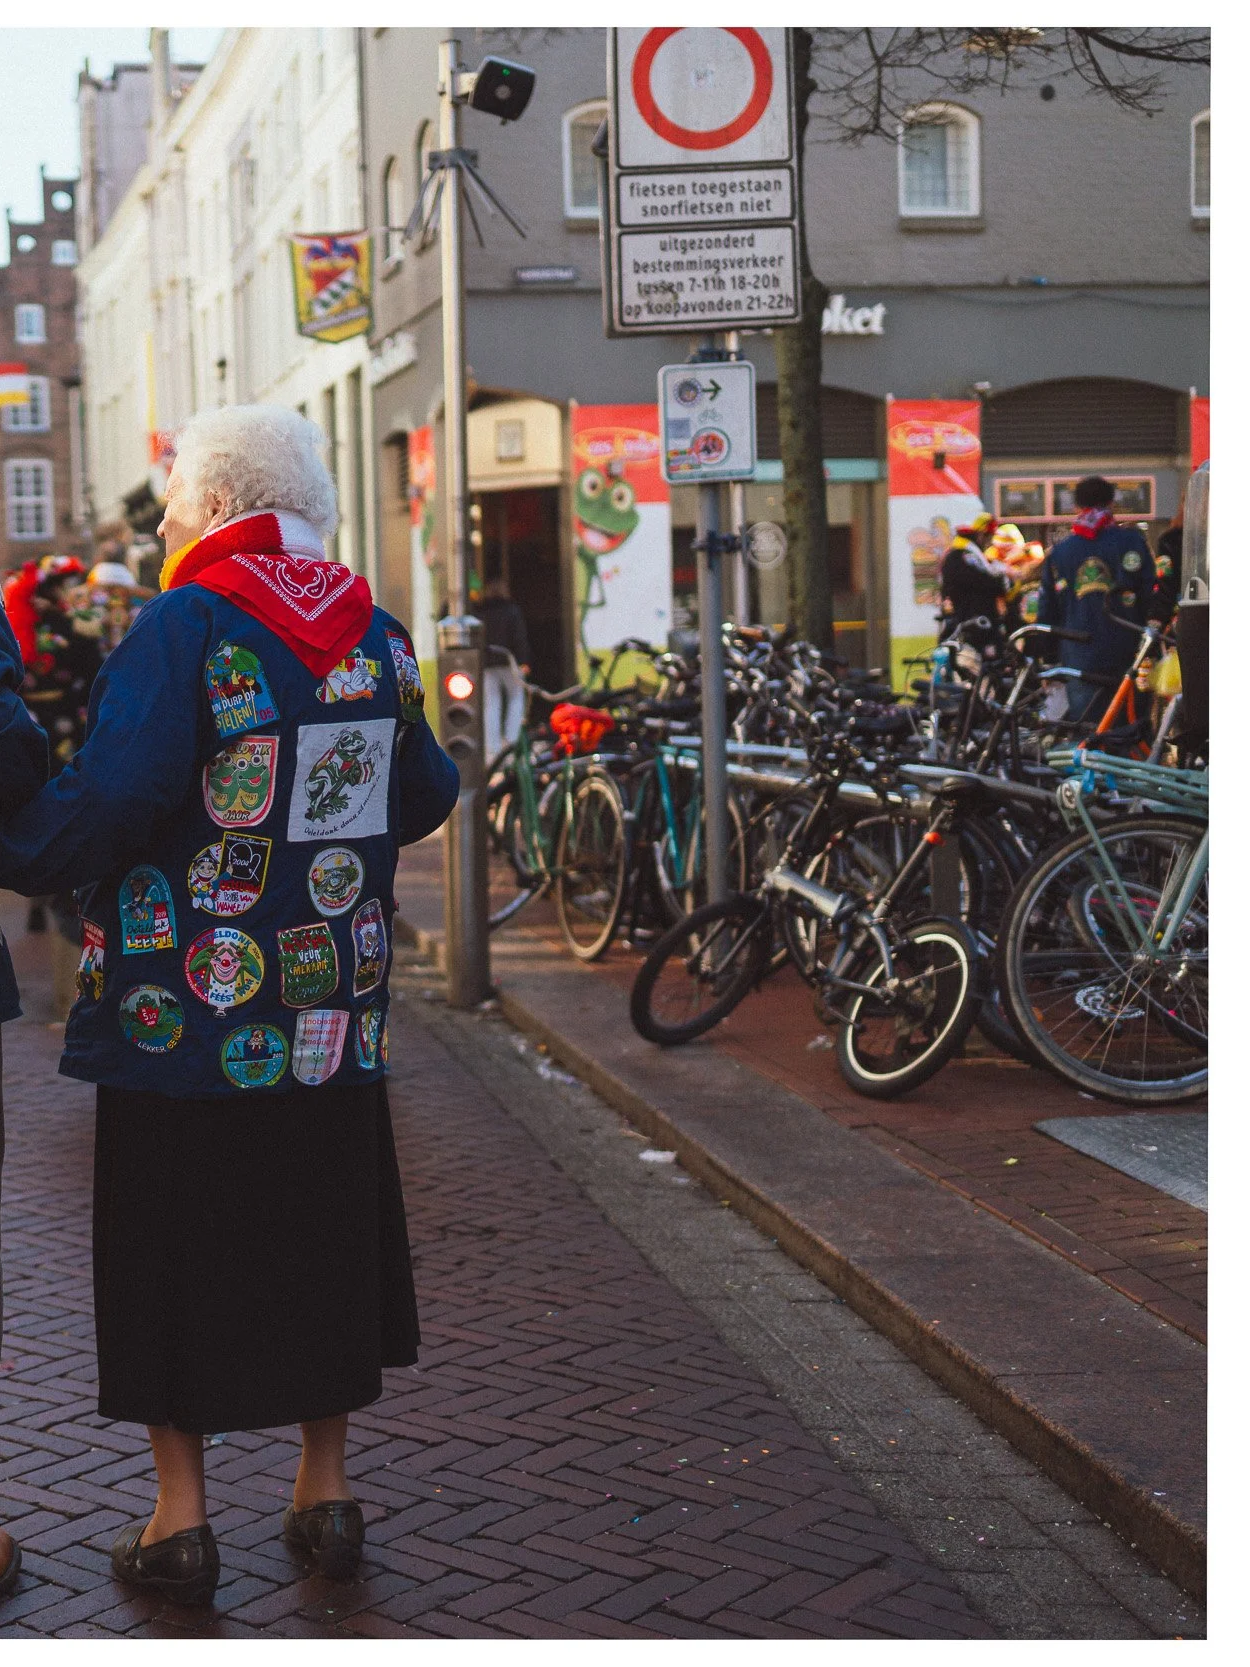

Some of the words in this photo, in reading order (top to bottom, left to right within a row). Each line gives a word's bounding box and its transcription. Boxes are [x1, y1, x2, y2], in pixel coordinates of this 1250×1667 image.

[629, 181, 686, 197] fietsen
[691, 177, 782, 197] toegestaan
[641, 199, 735, 218] snorfietsen
[740, 196, 771, 212] niet
[659, 233, 755, 254] uitgezonderd
[633, 253, 784, 274] bestemmingsverkeer
[637, 280, 684, 297] tussen
[689, 277, 726, 293] 7-11h
[730, 273, 780, 290] 18-20h
[625, 304, 641, 318] op
[646, 296, 742, 317] koopavonden
[746, 293, 793, 311] 21-22h
[222, 694, 243, 710] DURP
[244, 690, 256, 702] OP
[304, 826, 339, 836] Oeteldonk
[232, 858, 250, 866] 2004
[196, 930, 252, 948] OETELDONK
[138, 1042, 166, 1052] LEKKER
